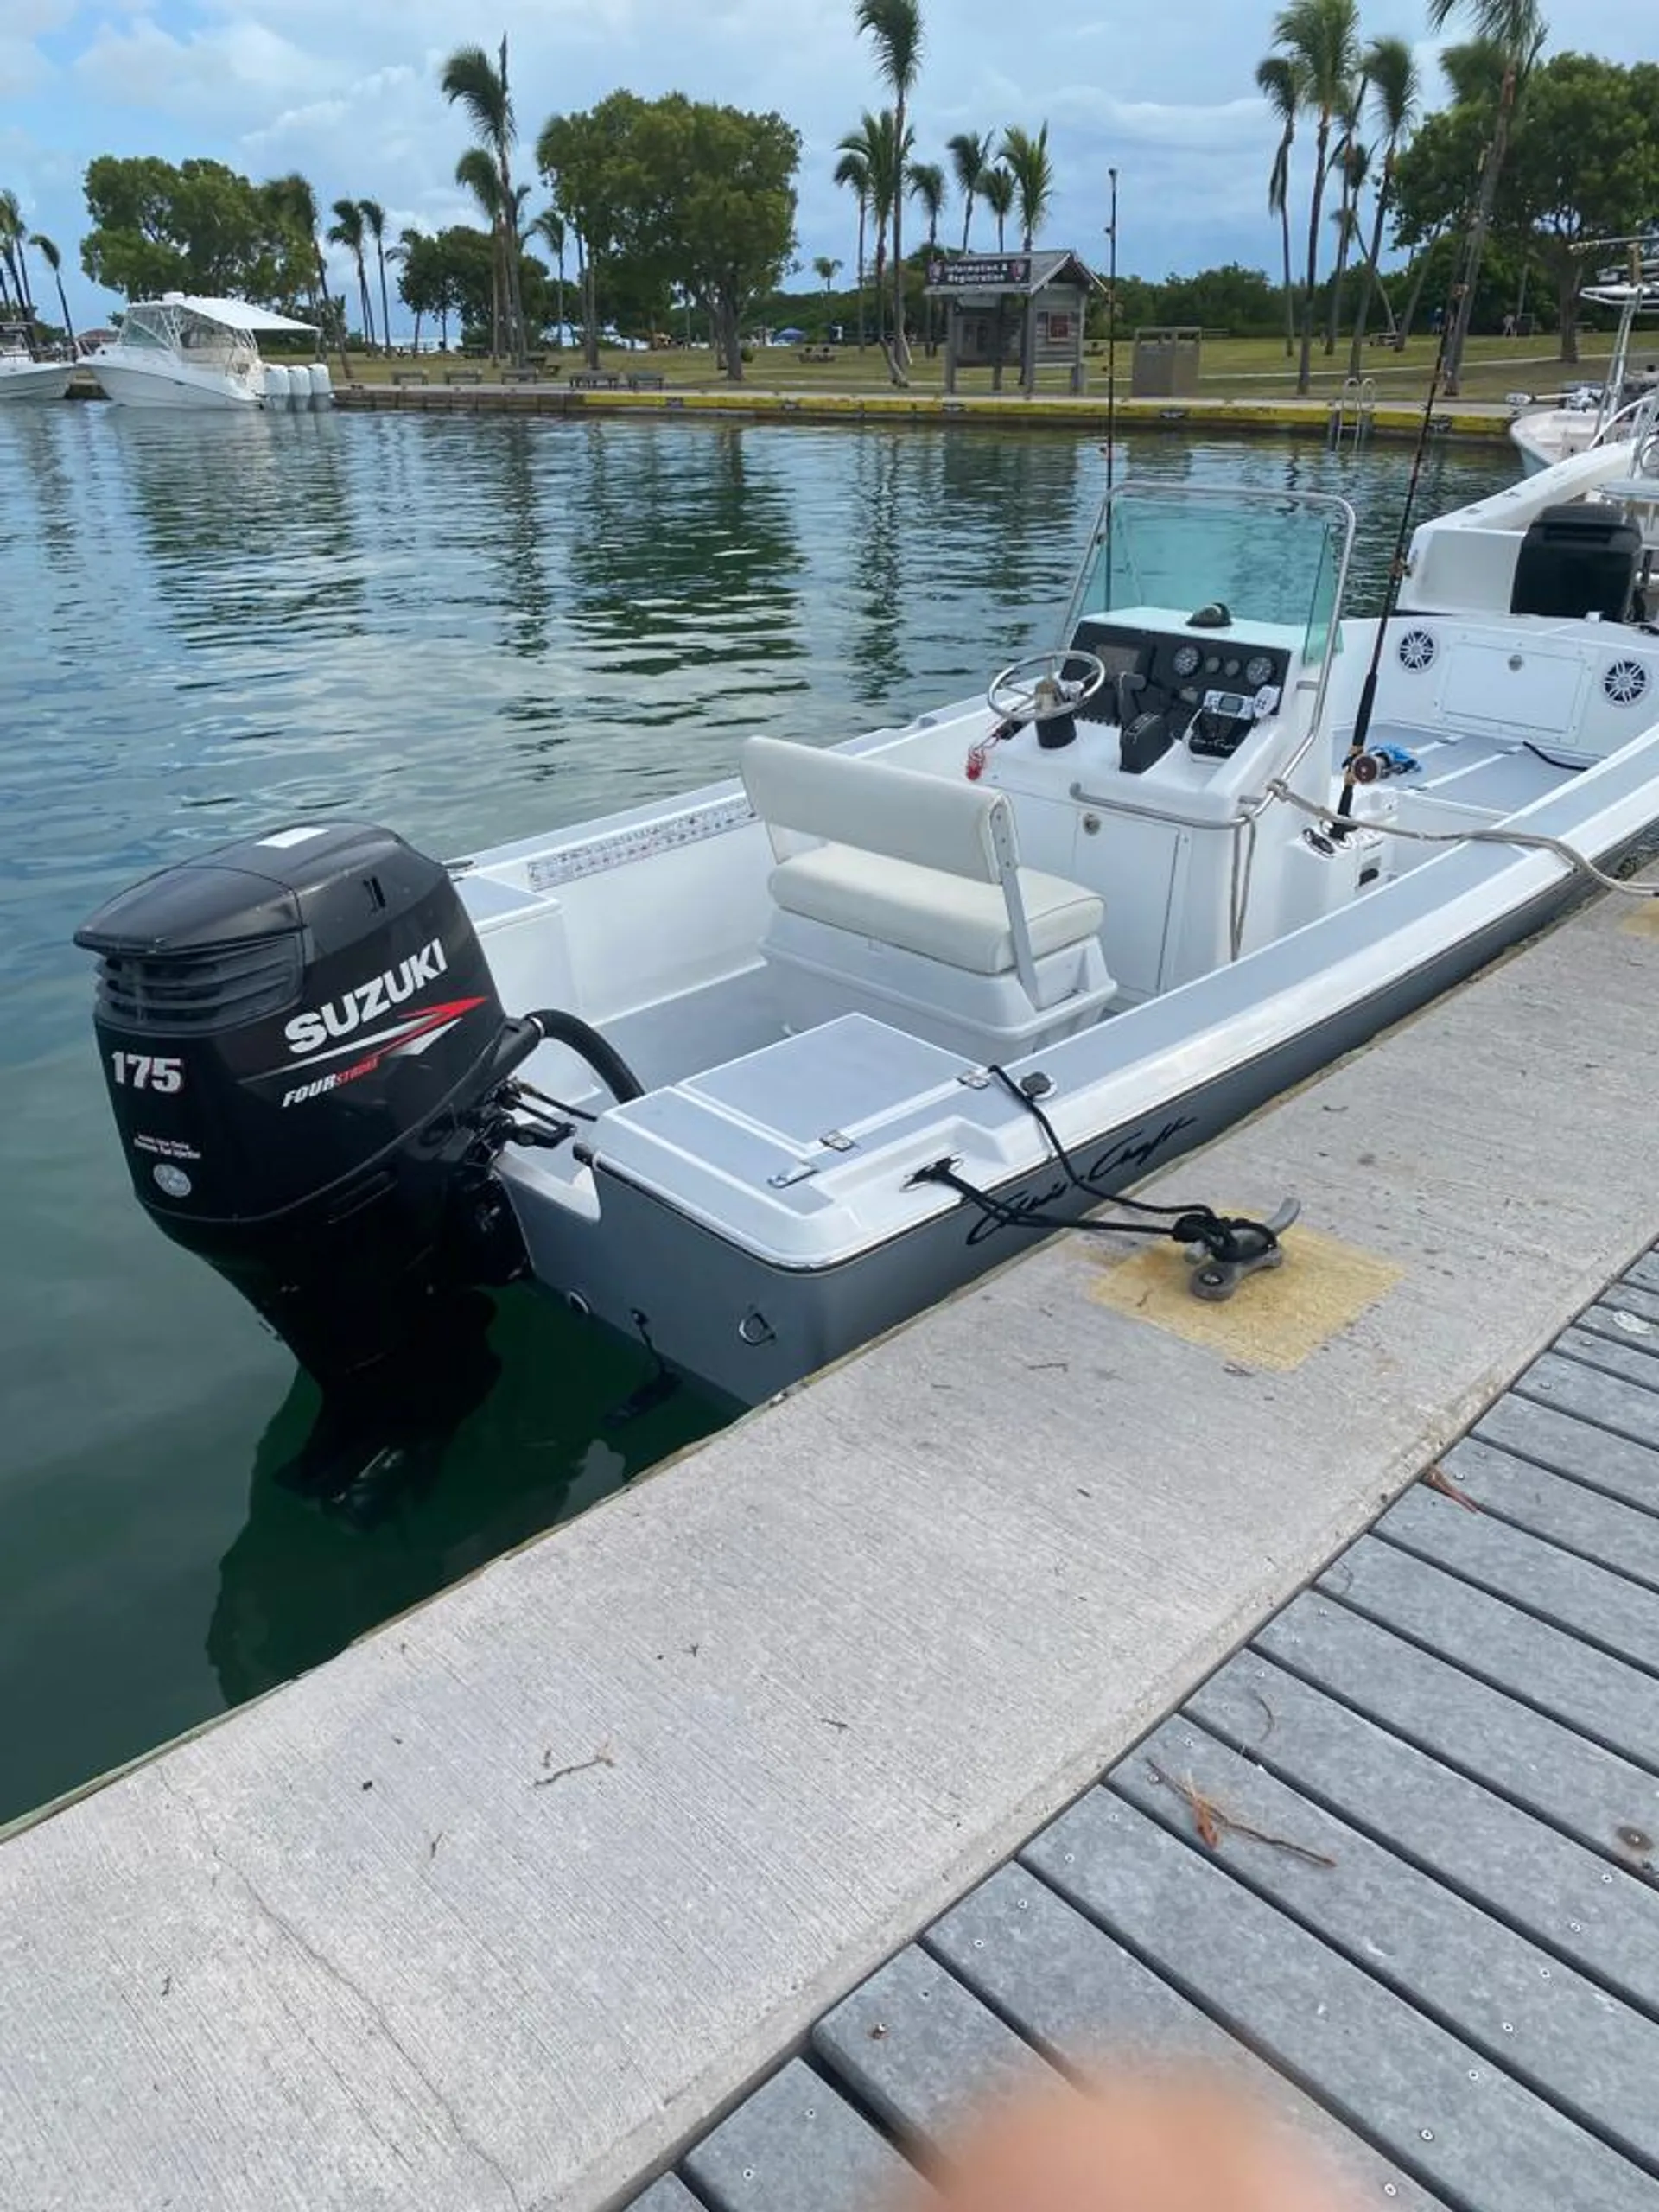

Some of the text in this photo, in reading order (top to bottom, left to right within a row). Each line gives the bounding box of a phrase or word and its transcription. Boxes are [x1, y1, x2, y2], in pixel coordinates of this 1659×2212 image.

[284, 938, 448, 1056] SUZUKI
[111, 1051, 185, 1094] 175
[281, 1071, 336, 1108] FOUR
